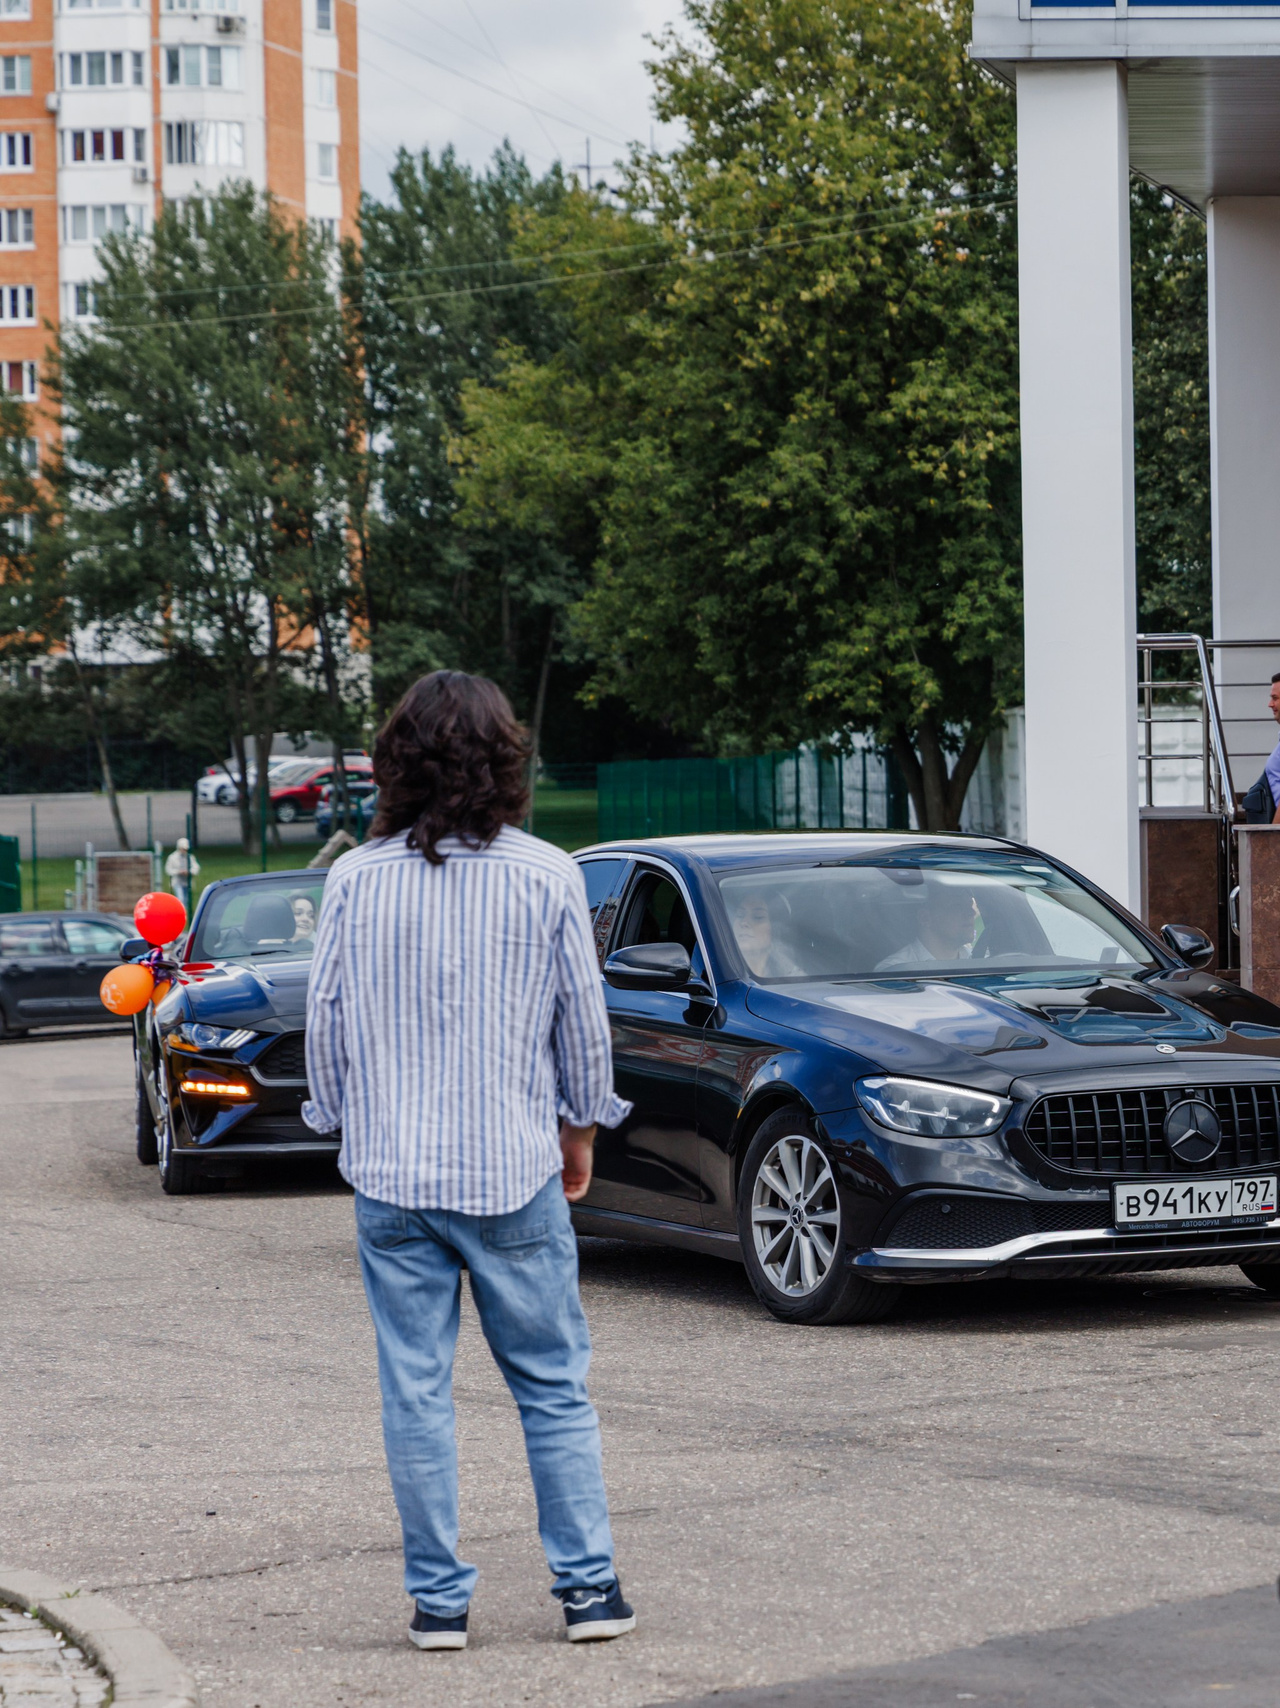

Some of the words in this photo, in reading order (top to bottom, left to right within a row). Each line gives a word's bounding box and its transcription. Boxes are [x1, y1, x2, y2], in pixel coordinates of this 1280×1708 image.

[1126, 1186, 1228, 1217] В941КУ
[1234, 1180, 1271, 1204] 797
[1242, 1203, 1260, 1212] RUS
[1181, 1219, 1220, 1228] АВТОФОРУМ
